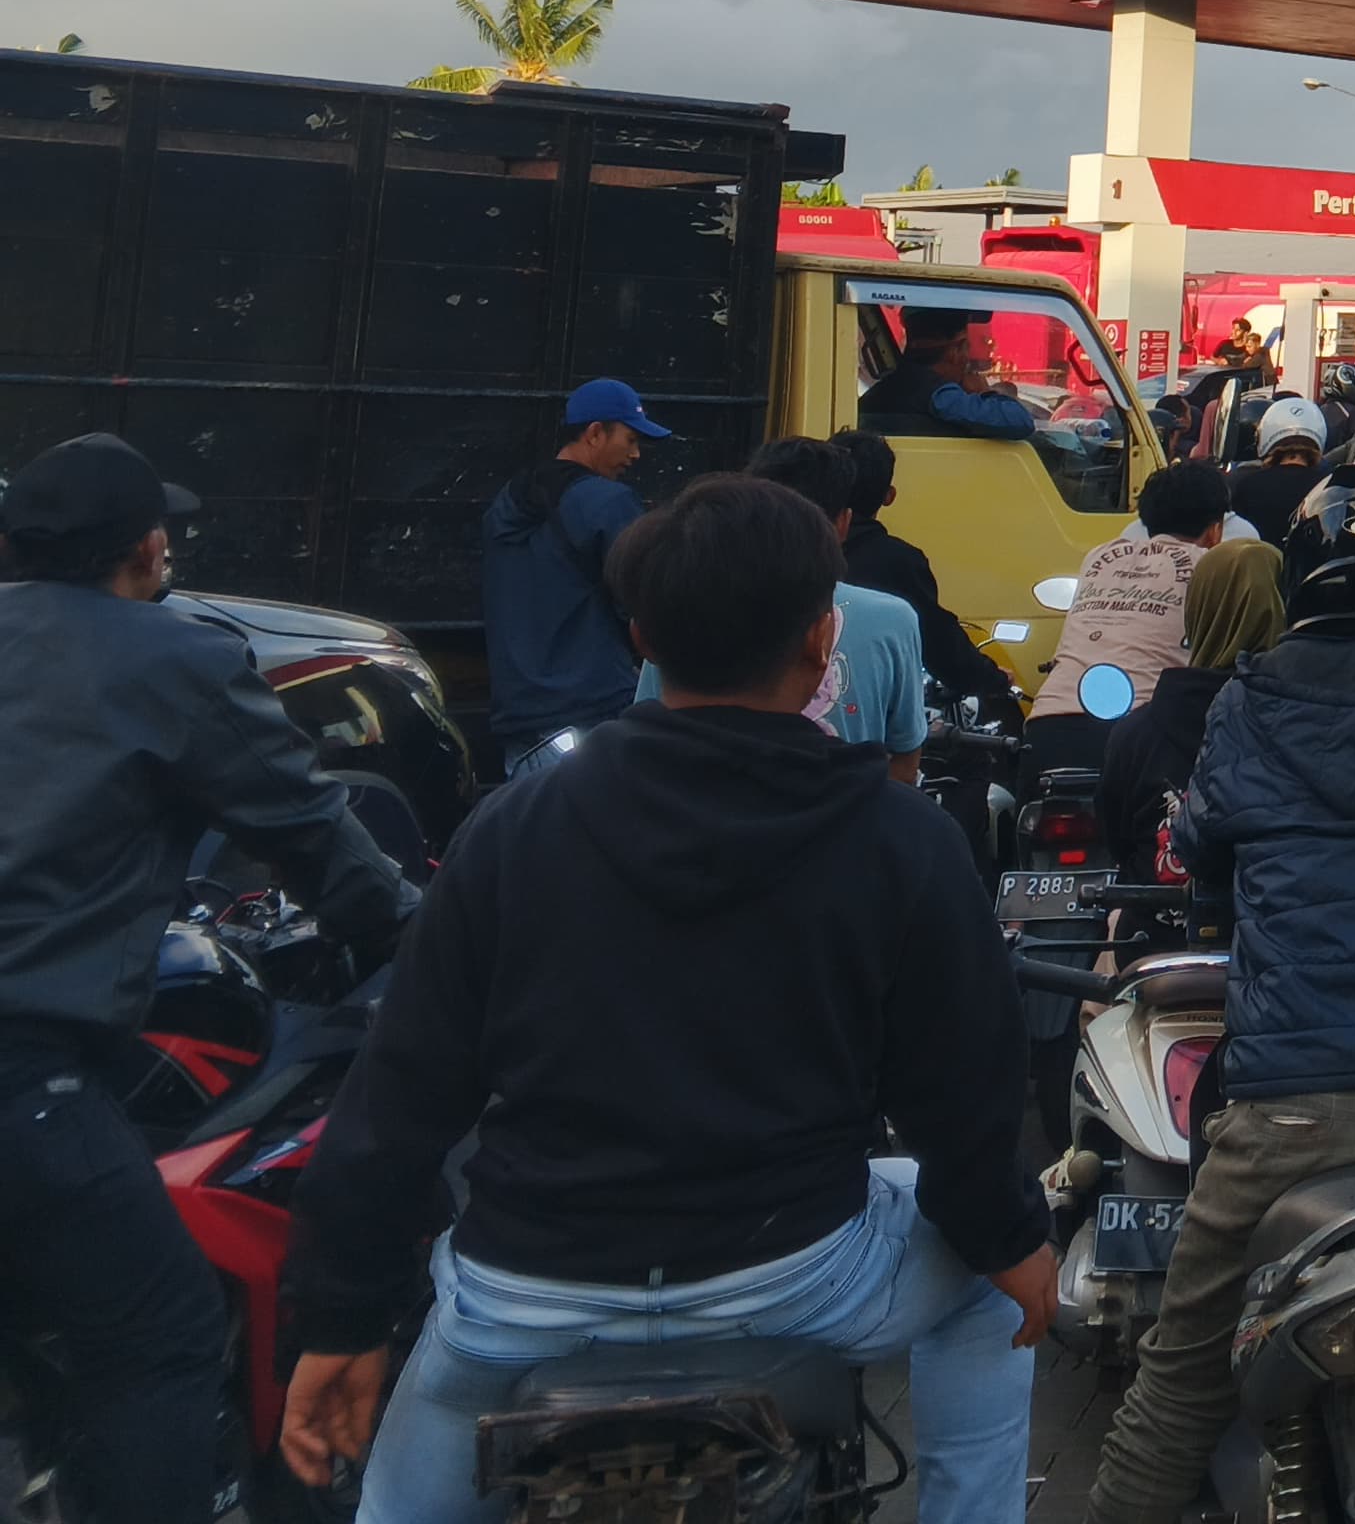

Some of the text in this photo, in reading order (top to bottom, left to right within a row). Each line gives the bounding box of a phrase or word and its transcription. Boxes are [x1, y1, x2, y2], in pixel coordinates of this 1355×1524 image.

[1111, 179, 1123, 199] 1
[1085, 545, 1134, 578] SPEED
[1138, 542, 1164, 557] AND
[1107, 584, 1183, 606] Angeles
[1109, 601, 1138, 612] MADE
[1139, 601, 1168, 616] CARS
[1003, 877, 1016, 896] P
[1101, 1201, 1140, 1231] DK
